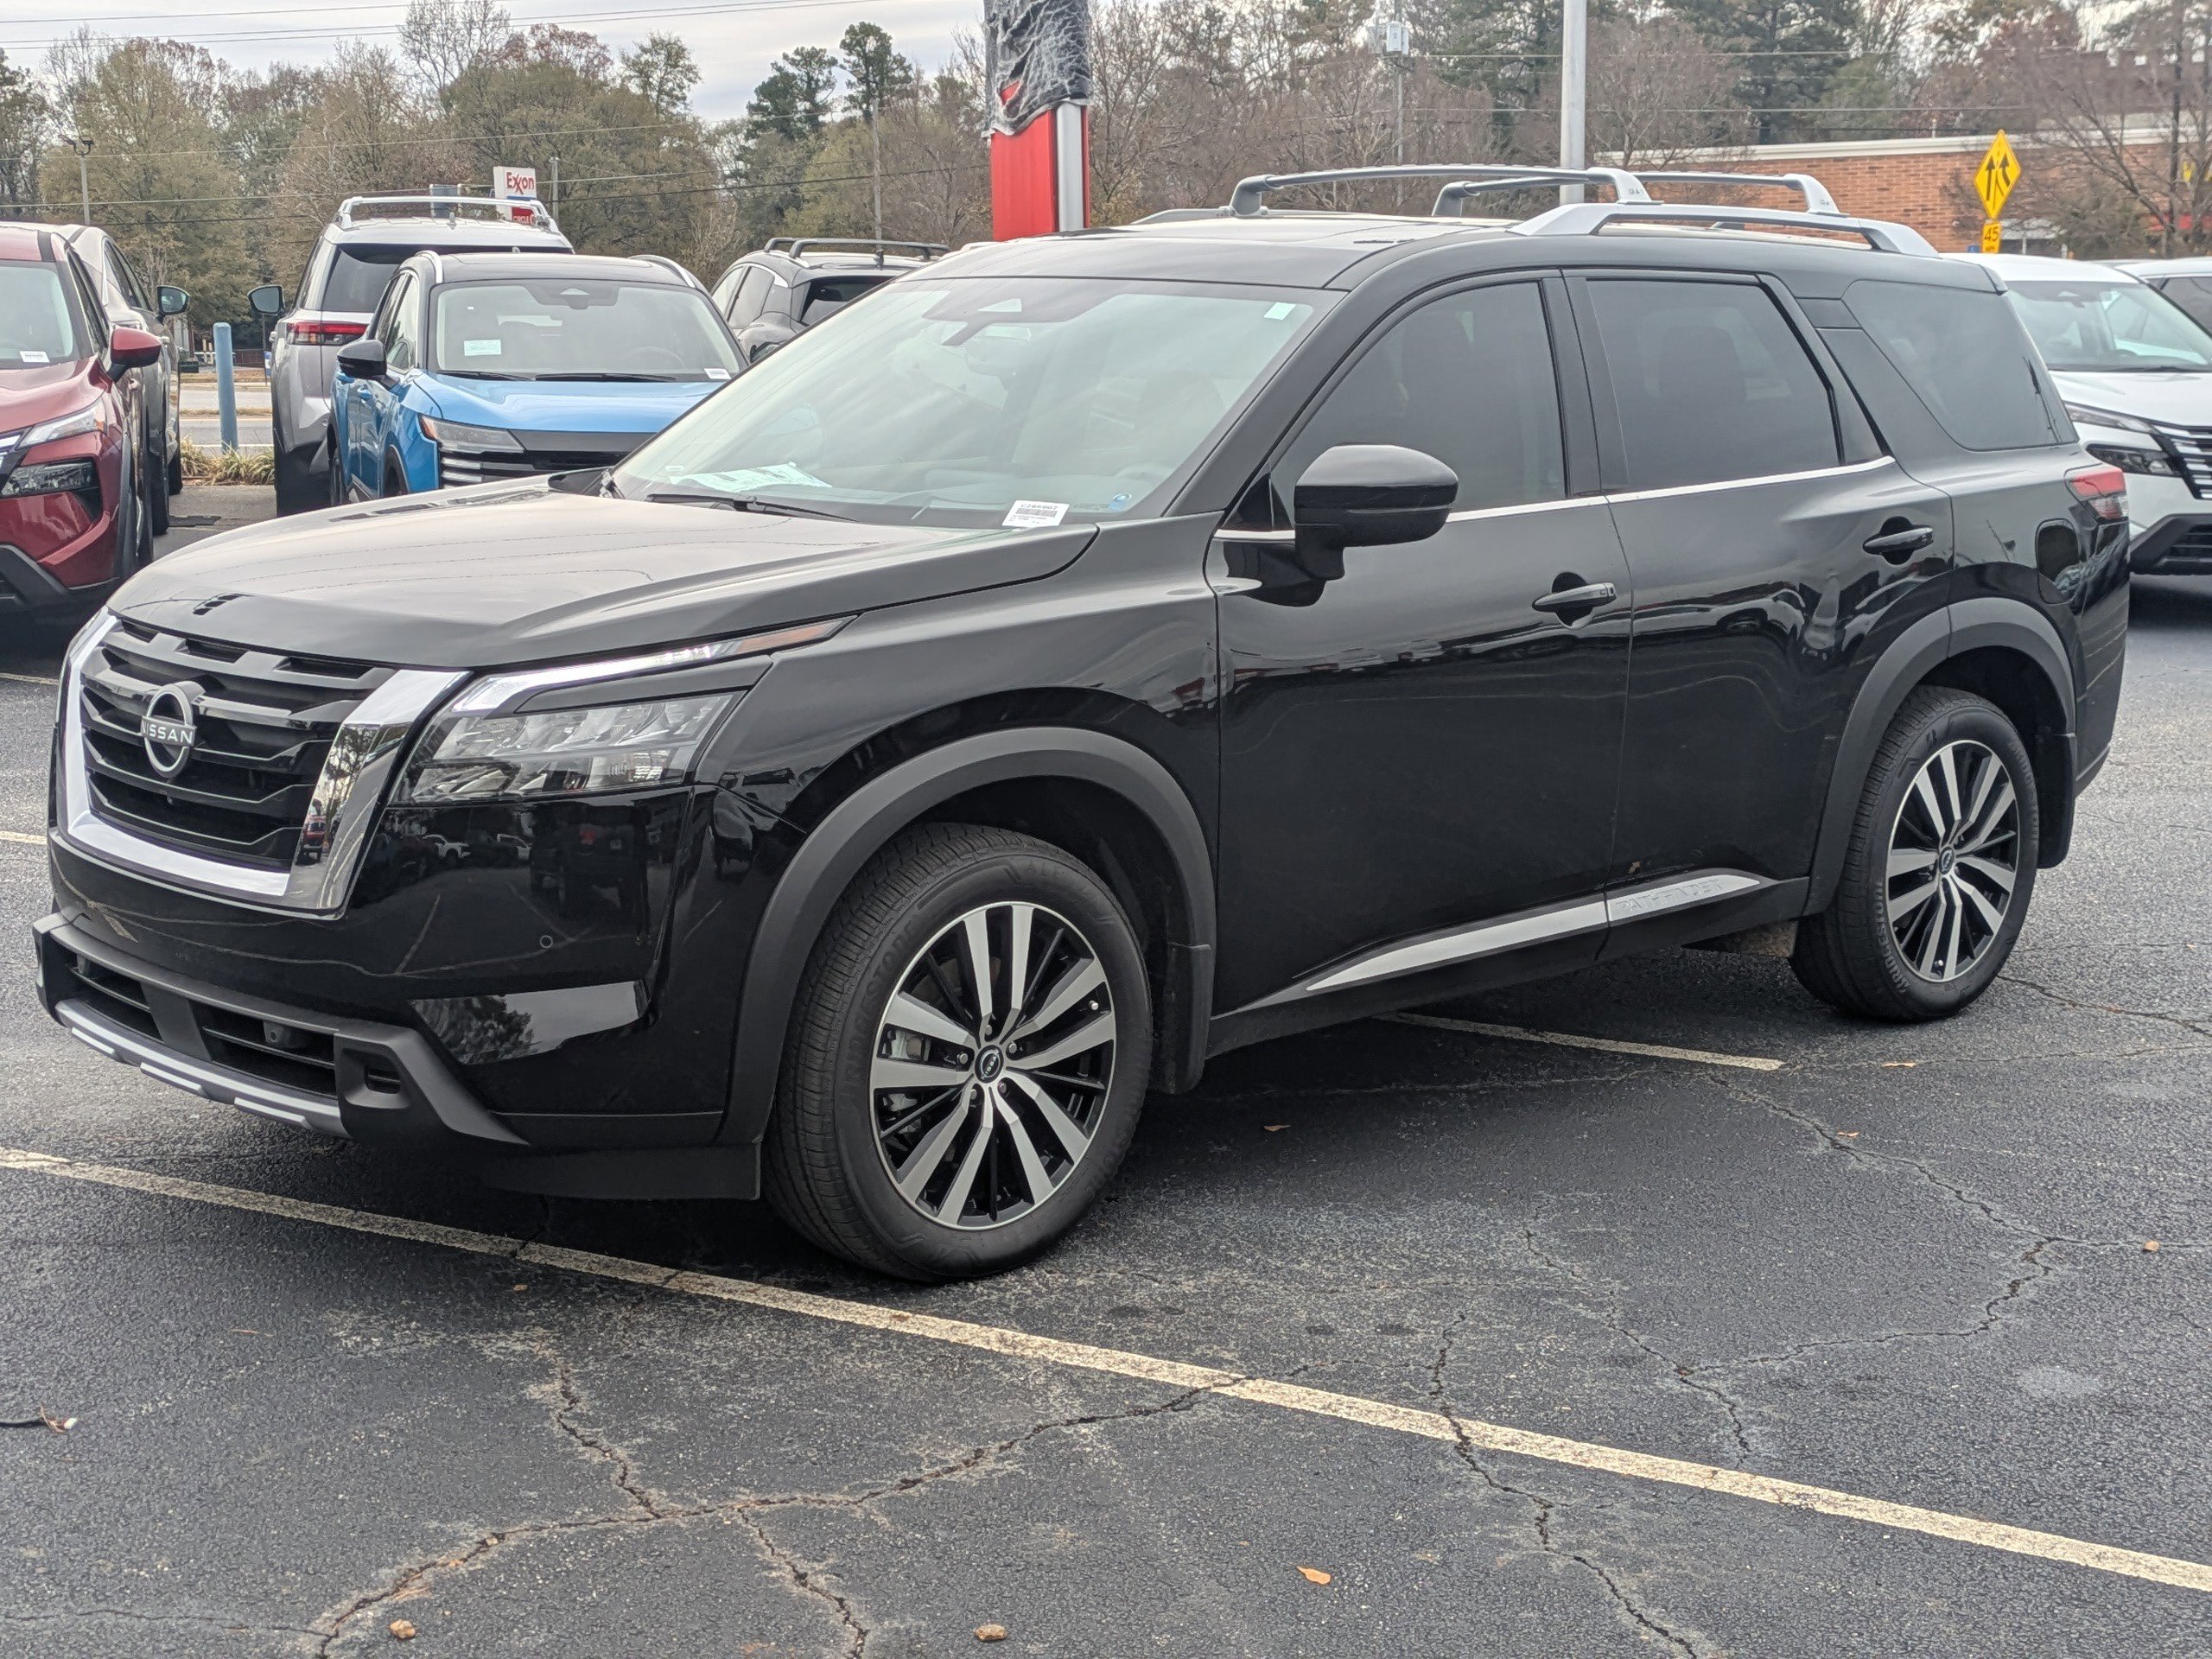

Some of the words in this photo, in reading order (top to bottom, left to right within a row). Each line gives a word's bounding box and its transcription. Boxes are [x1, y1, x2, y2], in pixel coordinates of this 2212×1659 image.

[506, 172, 534, 194] Exxon
[1985, 226, 1998, 242] 45
[142, 721, 193, 744] NISSAN
[1616, 880, 1723, 912] PATHFINDER
